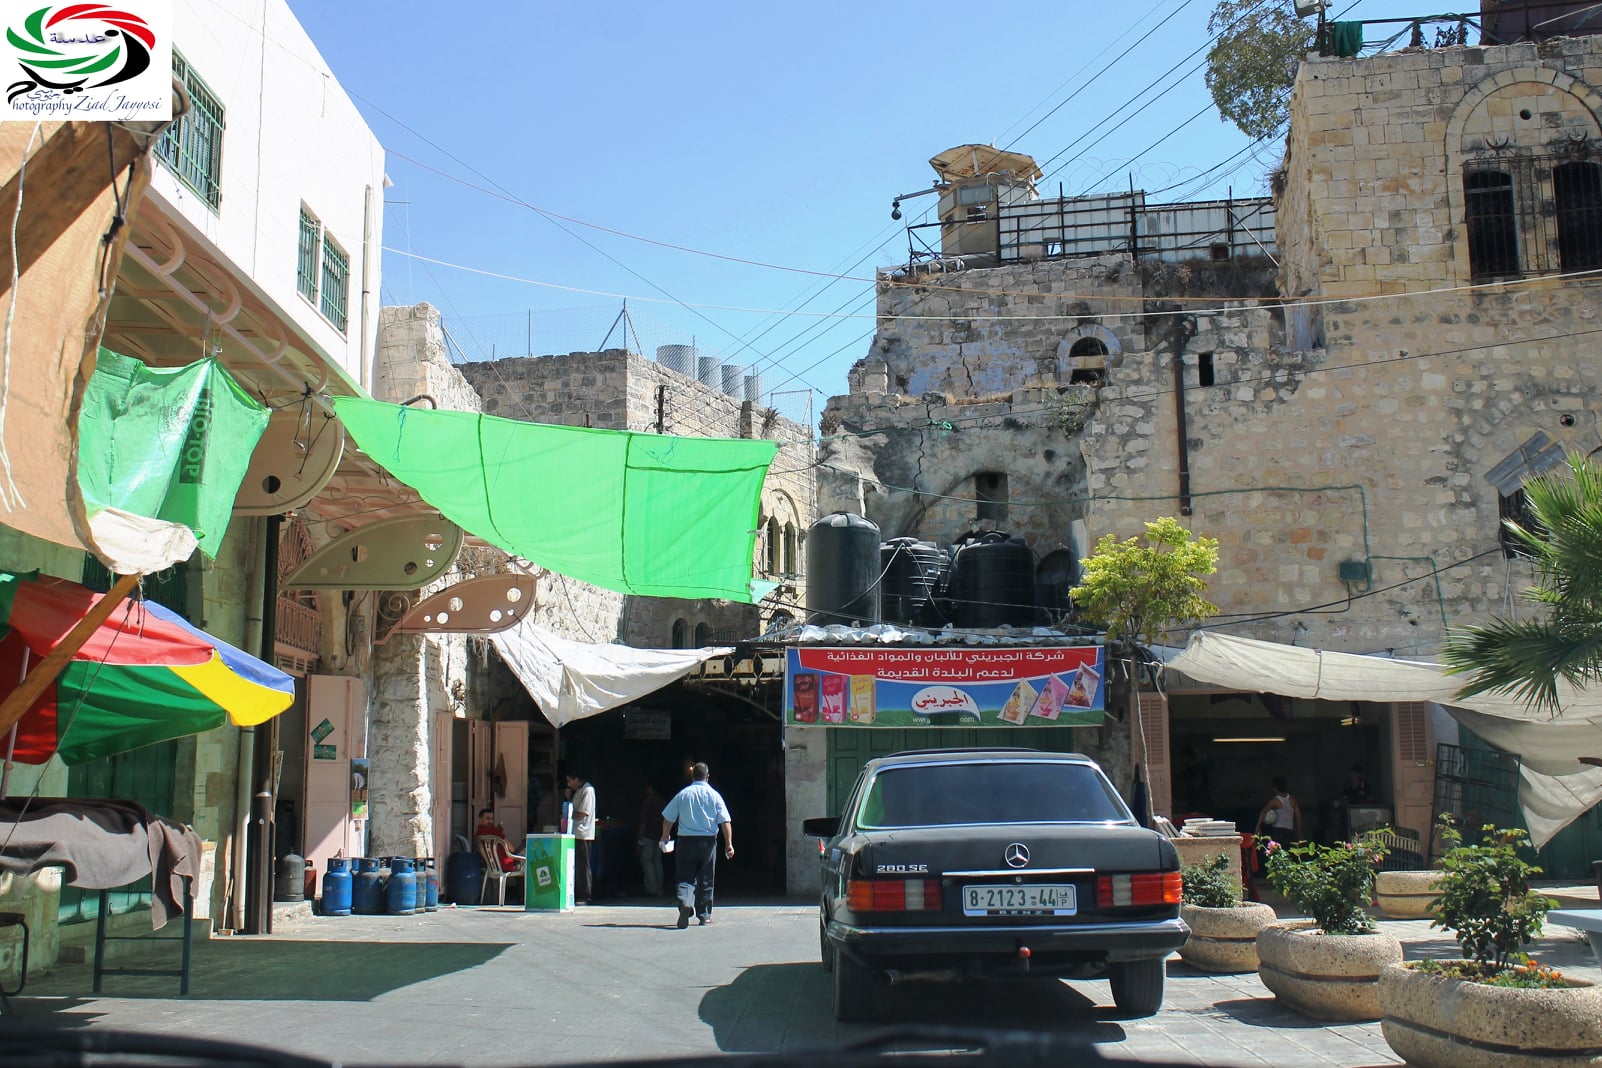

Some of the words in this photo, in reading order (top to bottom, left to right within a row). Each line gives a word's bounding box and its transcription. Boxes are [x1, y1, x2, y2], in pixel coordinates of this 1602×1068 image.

[827, 652, 874, 662] الغذائية
[878, 652, 921, 662] والمواد
[966, 652, 1022, 664] الجبريني
[1026, 650, 1064, 661] شركة
[877, 668, 929, 679] القديمة
[932, 668, 973, 679] البلدة
[976, 668, 1014, 679] لدعم
[915, 690, 969, 710] الجبريني
